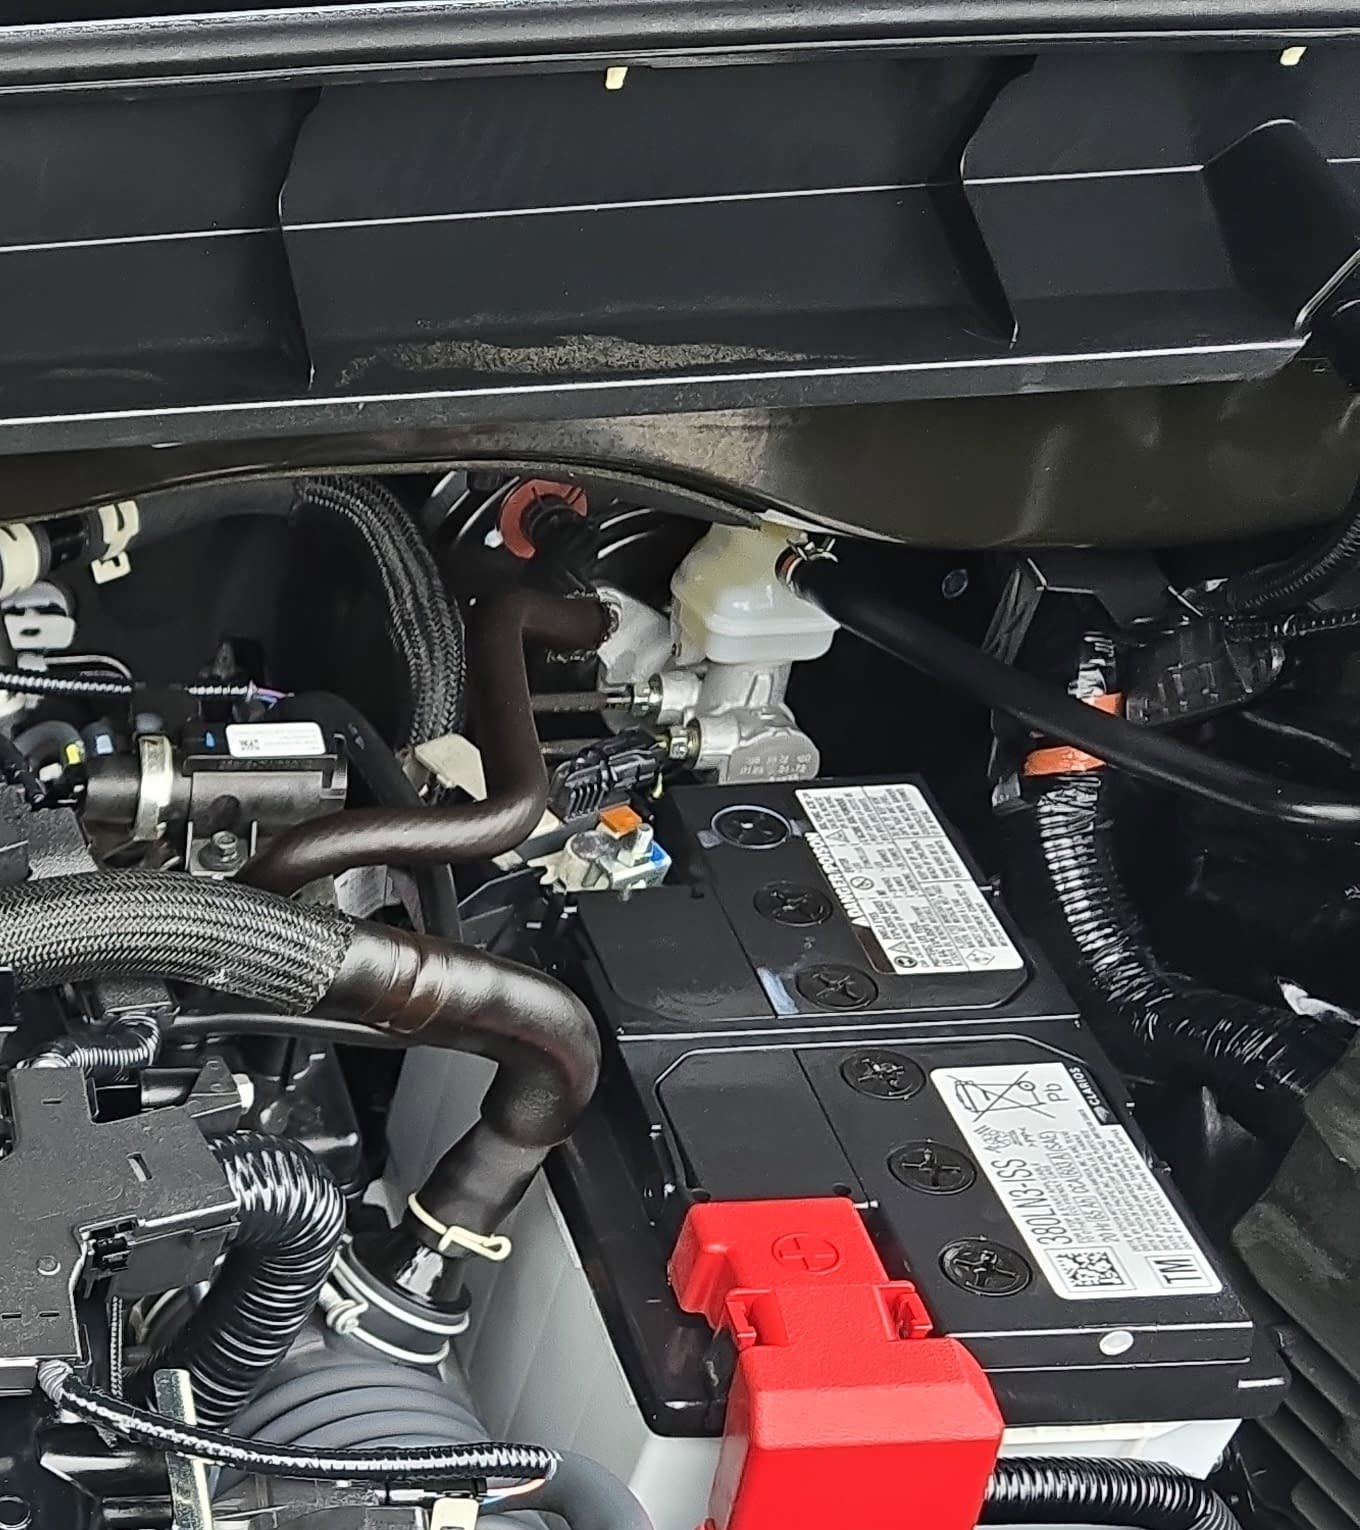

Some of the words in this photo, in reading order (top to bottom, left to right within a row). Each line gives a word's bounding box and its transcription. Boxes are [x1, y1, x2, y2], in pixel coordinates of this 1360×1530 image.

[1039, 1082, 1071, 1102] Pb
[1067, 1066, 1101, 1106] CLARIOS
[988, 1157, 1075, 1246] 380LN3-ISS
[1151, 1257, 1204, 1283] TM
